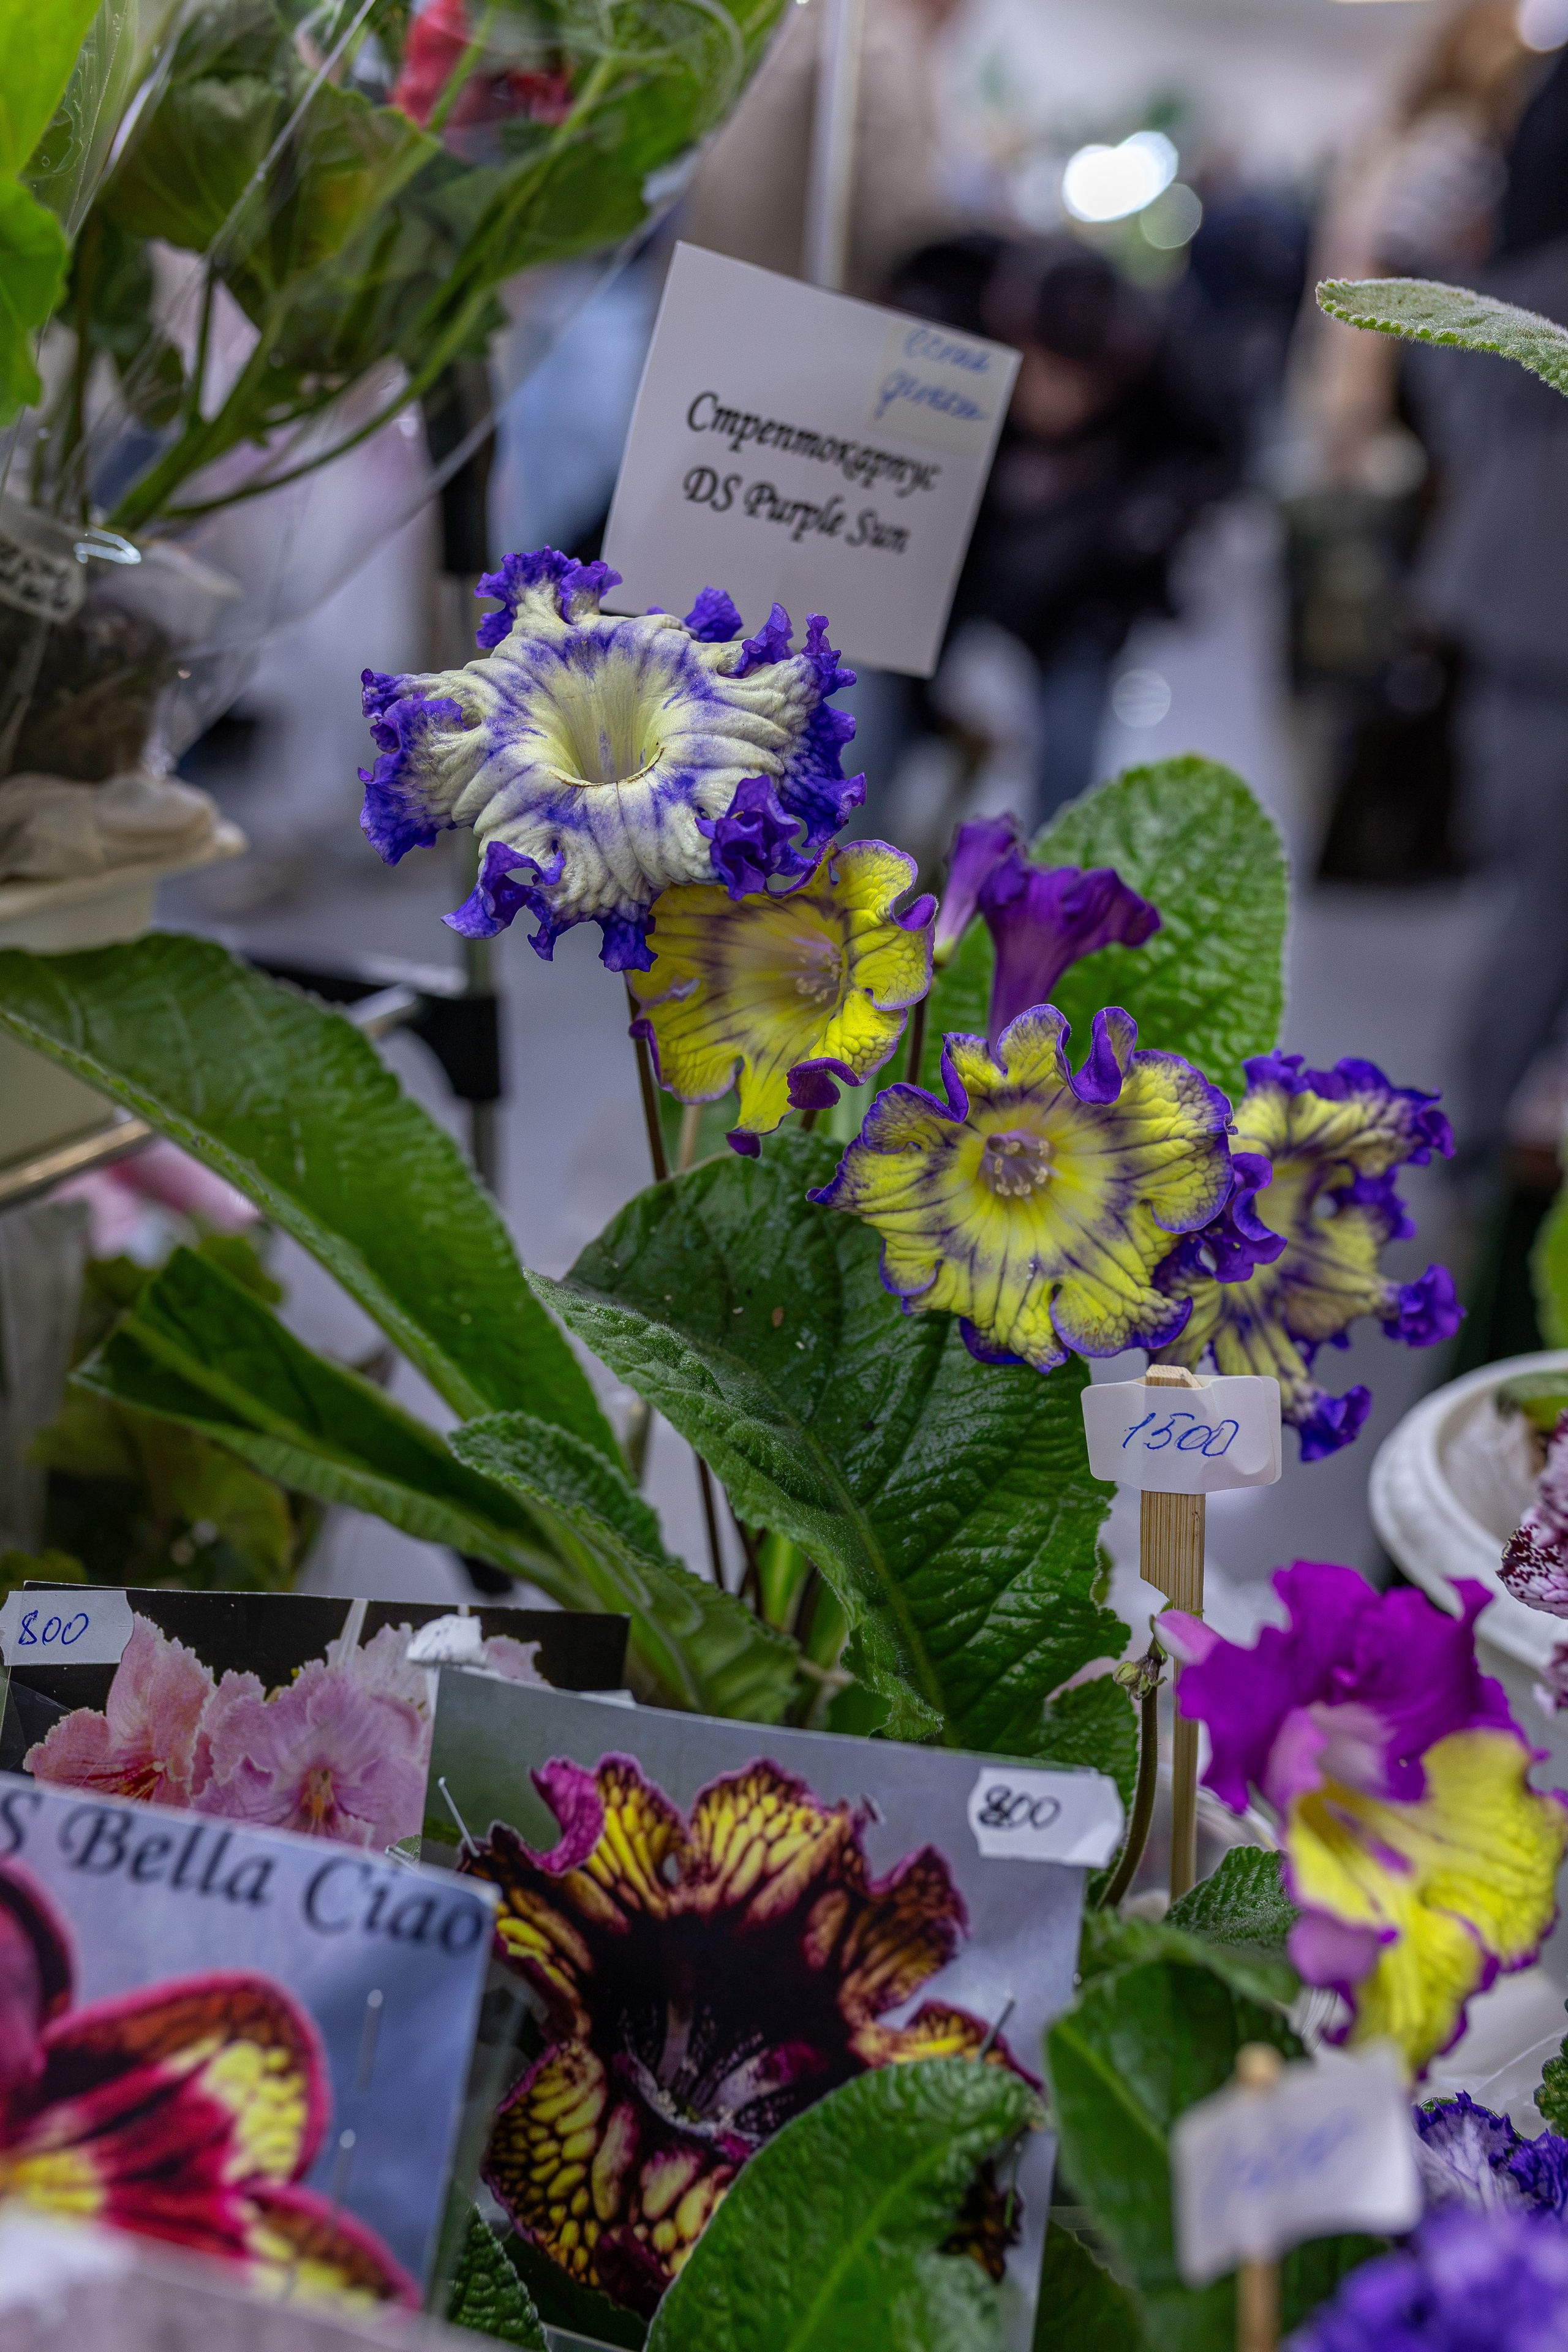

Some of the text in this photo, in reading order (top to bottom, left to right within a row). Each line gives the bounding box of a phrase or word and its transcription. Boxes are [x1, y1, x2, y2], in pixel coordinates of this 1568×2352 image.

[682, 465, 911, 554] DS Purple Sun
[1122, 1412, 1240, 1457] 1500
[17, 1609, 90, 1646] 800
[978, 1783, 1061, 1831] 800
[57, 1801, 278, 1907] Bella
[301, 1852, 485, 1956] Ciao
